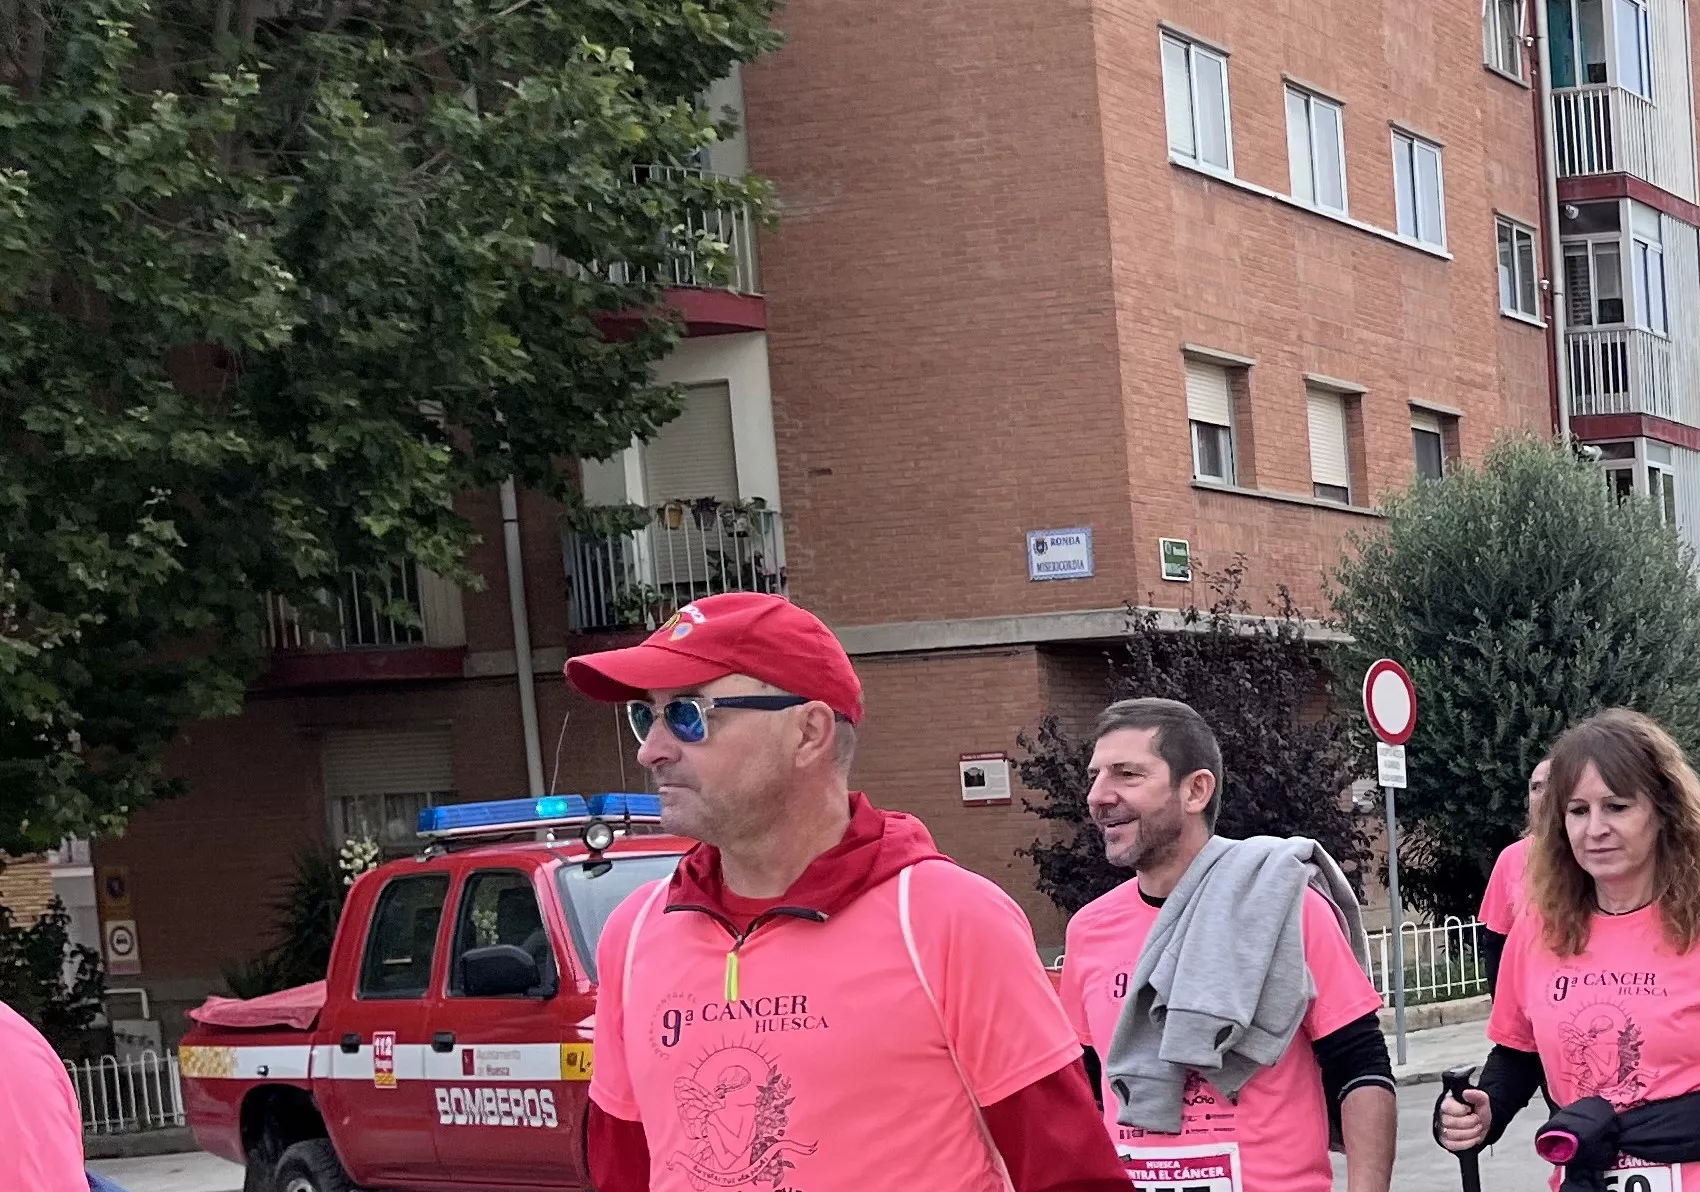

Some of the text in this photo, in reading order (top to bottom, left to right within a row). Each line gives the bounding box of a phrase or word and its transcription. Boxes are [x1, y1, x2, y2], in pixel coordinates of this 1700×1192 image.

[1050, 536, 1080, 546] RONDA
[1036, 559, 1085, 572] MISERICORDIA
[1583, 970, 1656, 986] CÁNCER
[1618, 987, 1668, 997] HUESCA
[755, 1016, 829, 1033] HUESCA
[434, 1087, 559, 1128] BOMBEROS
[1146, 1161, 1180, 1169] HUESCA
[1160, 1170, 1173, 1180] EL
[1173, 1166, 1225, 1180] CÁNCER
